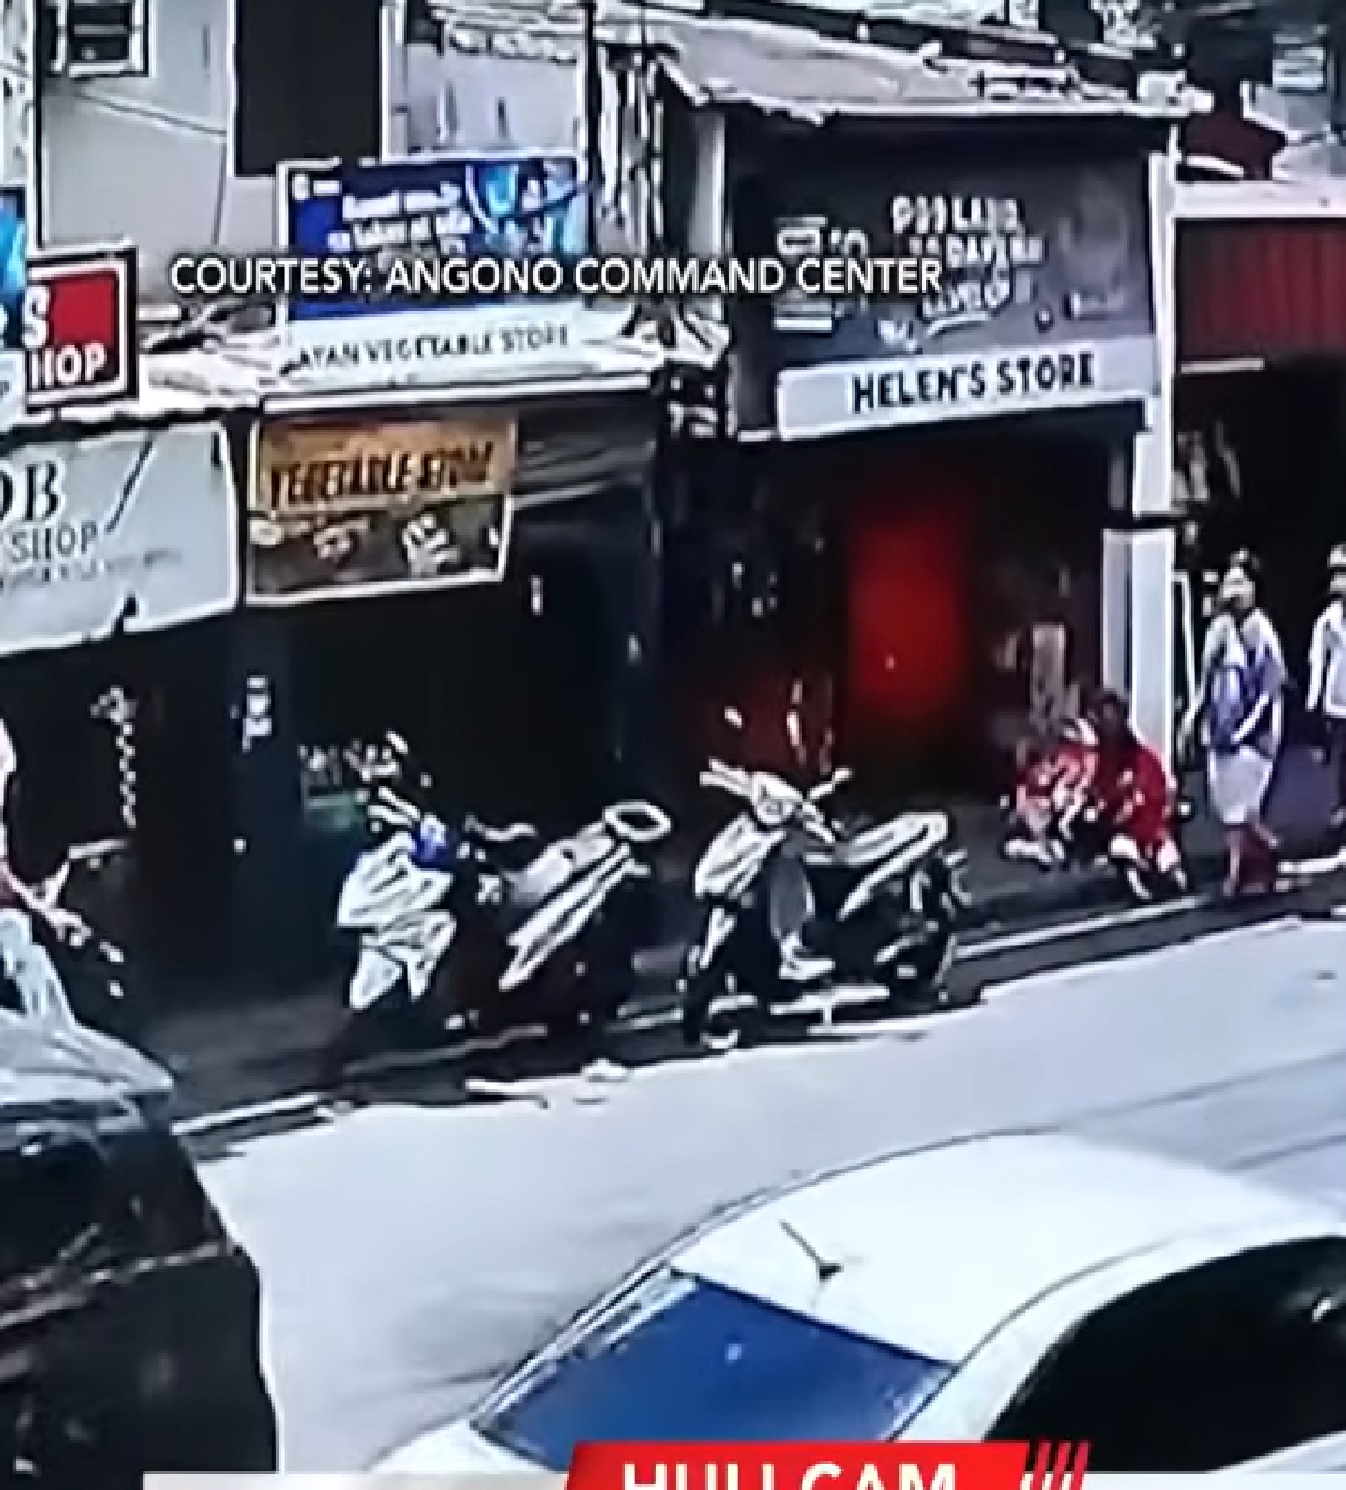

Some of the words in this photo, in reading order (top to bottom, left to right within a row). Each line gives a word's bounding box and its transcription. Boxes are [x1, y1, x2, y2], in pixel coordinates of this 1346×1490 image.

[362, 332, 492, 364] VEGETABLE
[501, 320, 569, 355] STORE
[851, 360, 986, 415] HELEN'S
[996, 351, 1096, 396] STORE
[10, 520, 98, 564] SHOP
